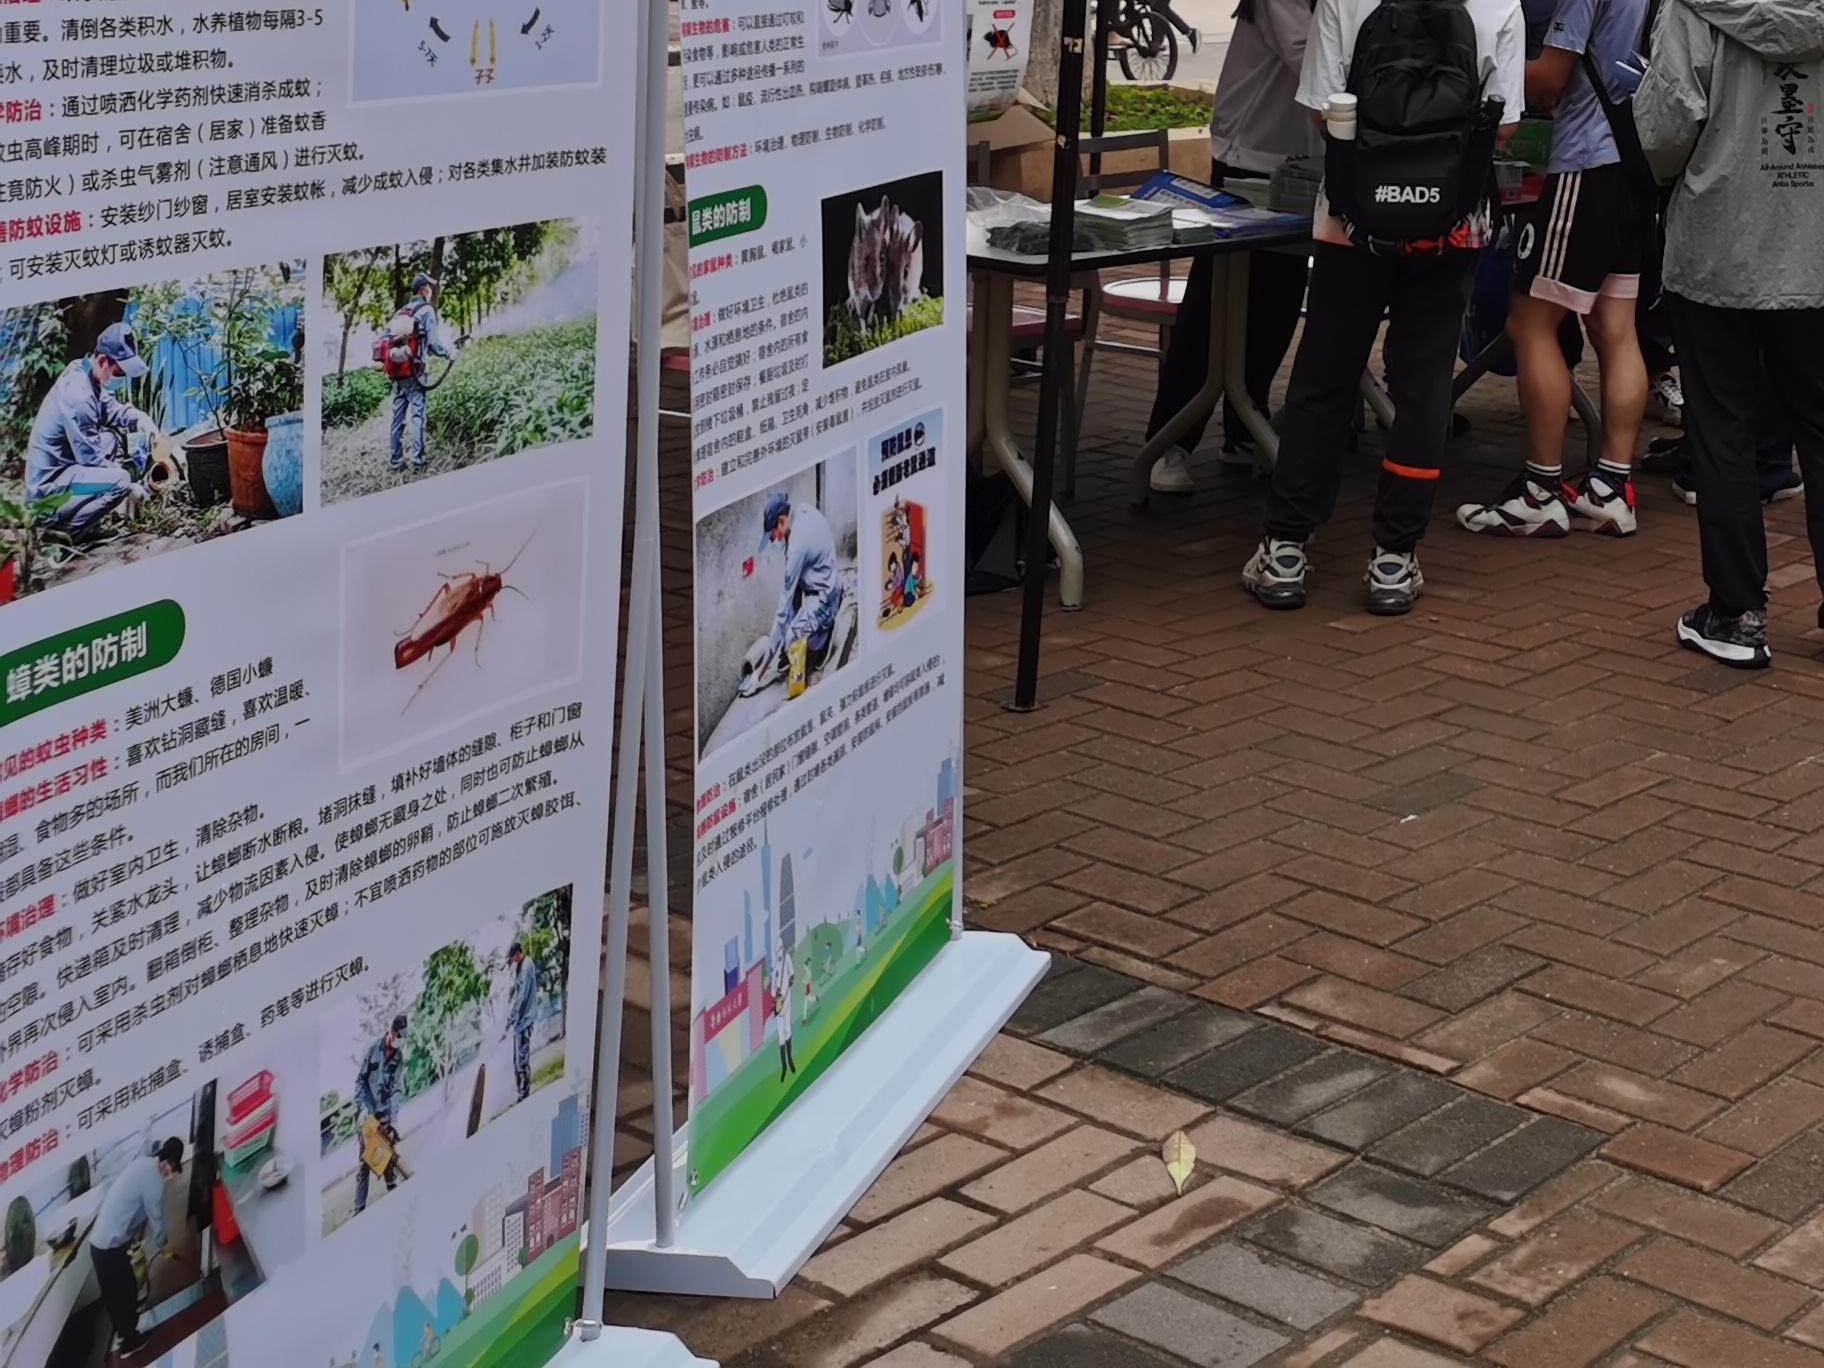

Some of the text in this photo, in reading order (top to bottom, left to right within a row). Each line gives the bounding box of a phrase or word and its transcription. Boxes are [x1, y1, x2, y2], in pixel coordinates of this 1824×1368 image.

[0, 9, 323, 44] 重要。清倒各类积水，水养植物每隔3-5
[1375, 185, 1440, 203] #BAD5
[0, 229, 232, 281] 可安装灭蚊灯或诱蚊器灭蚊。
[6, 621, 147, 705] 蟑类的防制
[0, 824, 134, 903] 都具备这些条件。
